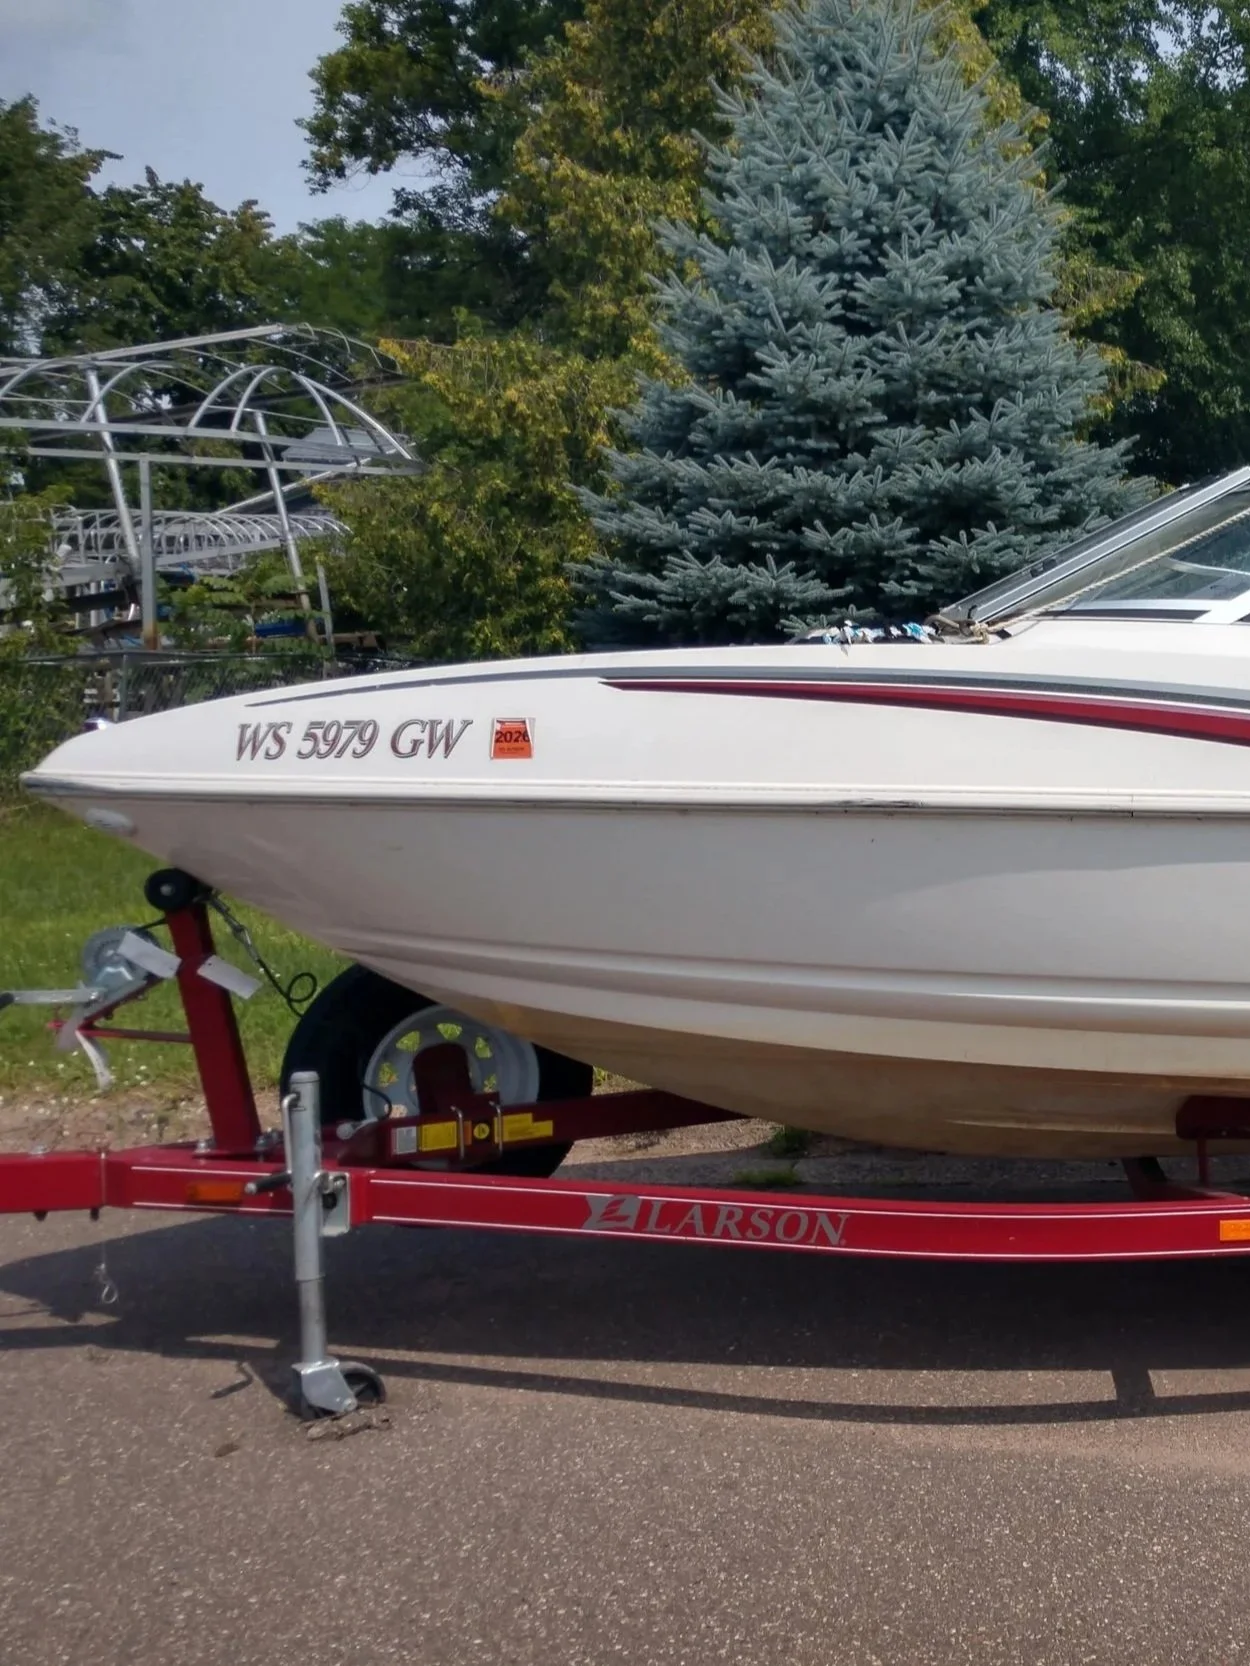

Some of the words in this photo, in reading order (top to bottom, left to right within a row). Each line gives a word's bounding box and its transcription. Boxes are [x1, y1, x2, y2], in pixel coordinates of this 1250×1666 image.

[236, 721, 293, 761] WS
[296, 719, 380, 760] 5979
[390, 717, 474, 760] GW
[642, 1199, 850, 1246] LARSON
